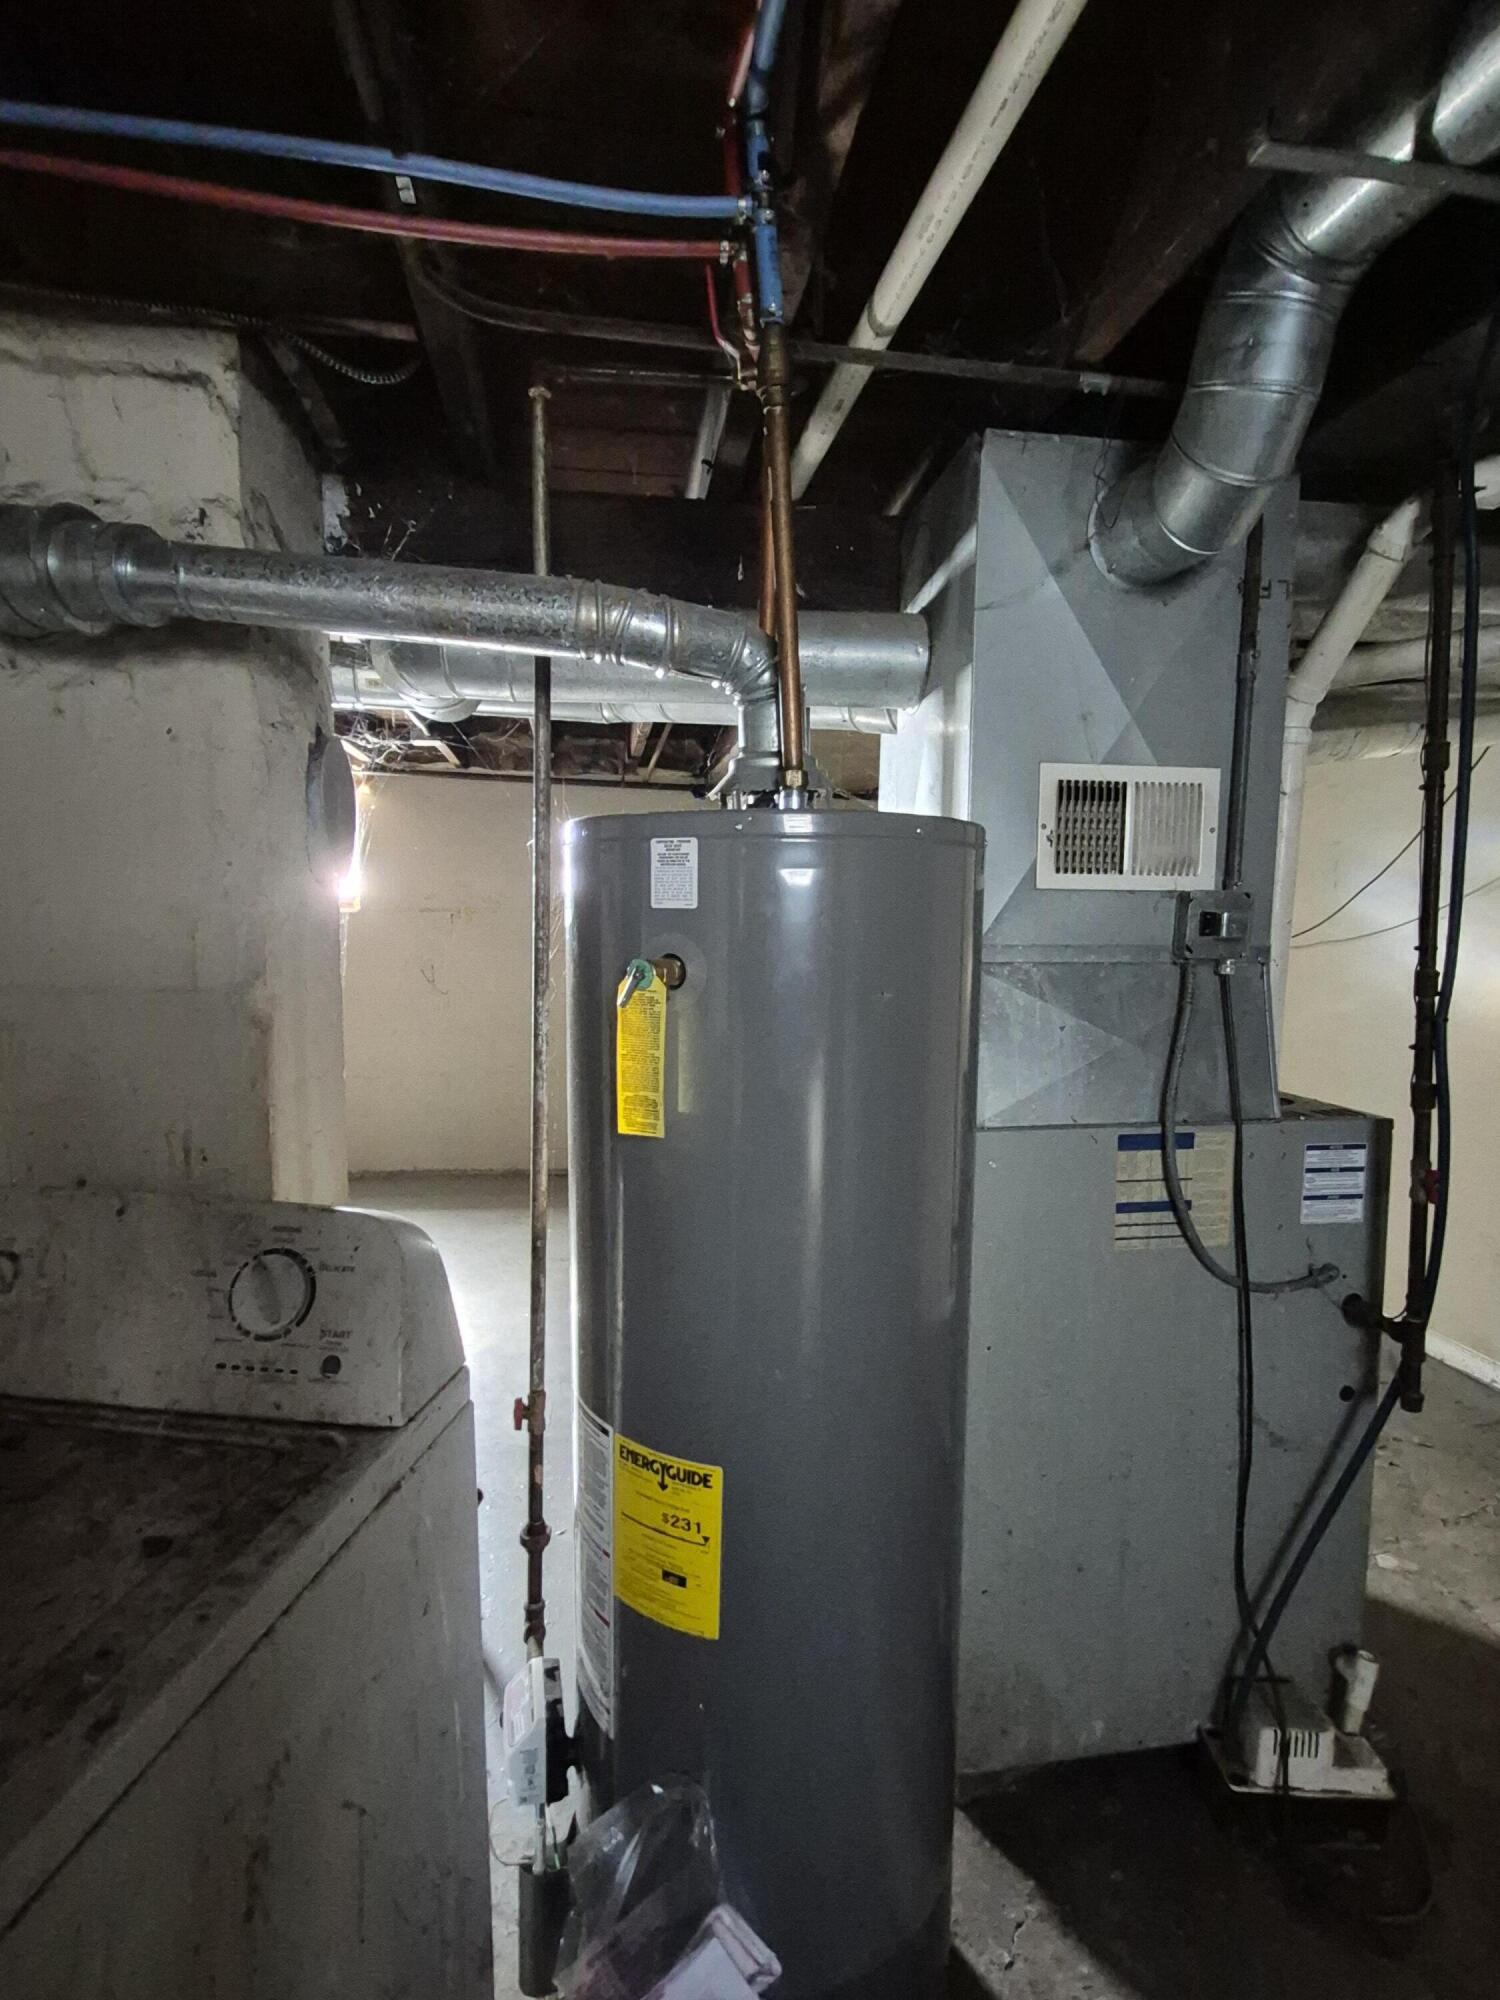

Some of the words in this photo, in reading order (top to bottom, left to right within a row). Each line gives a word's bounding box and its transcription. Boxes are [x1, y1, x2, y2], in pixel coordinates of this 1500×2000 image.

[320, 1329, 352, 1339] START
[620, 1445, 713, 1489] ENERGYGUIDE
[661, 1512, 701, 1534] $231
